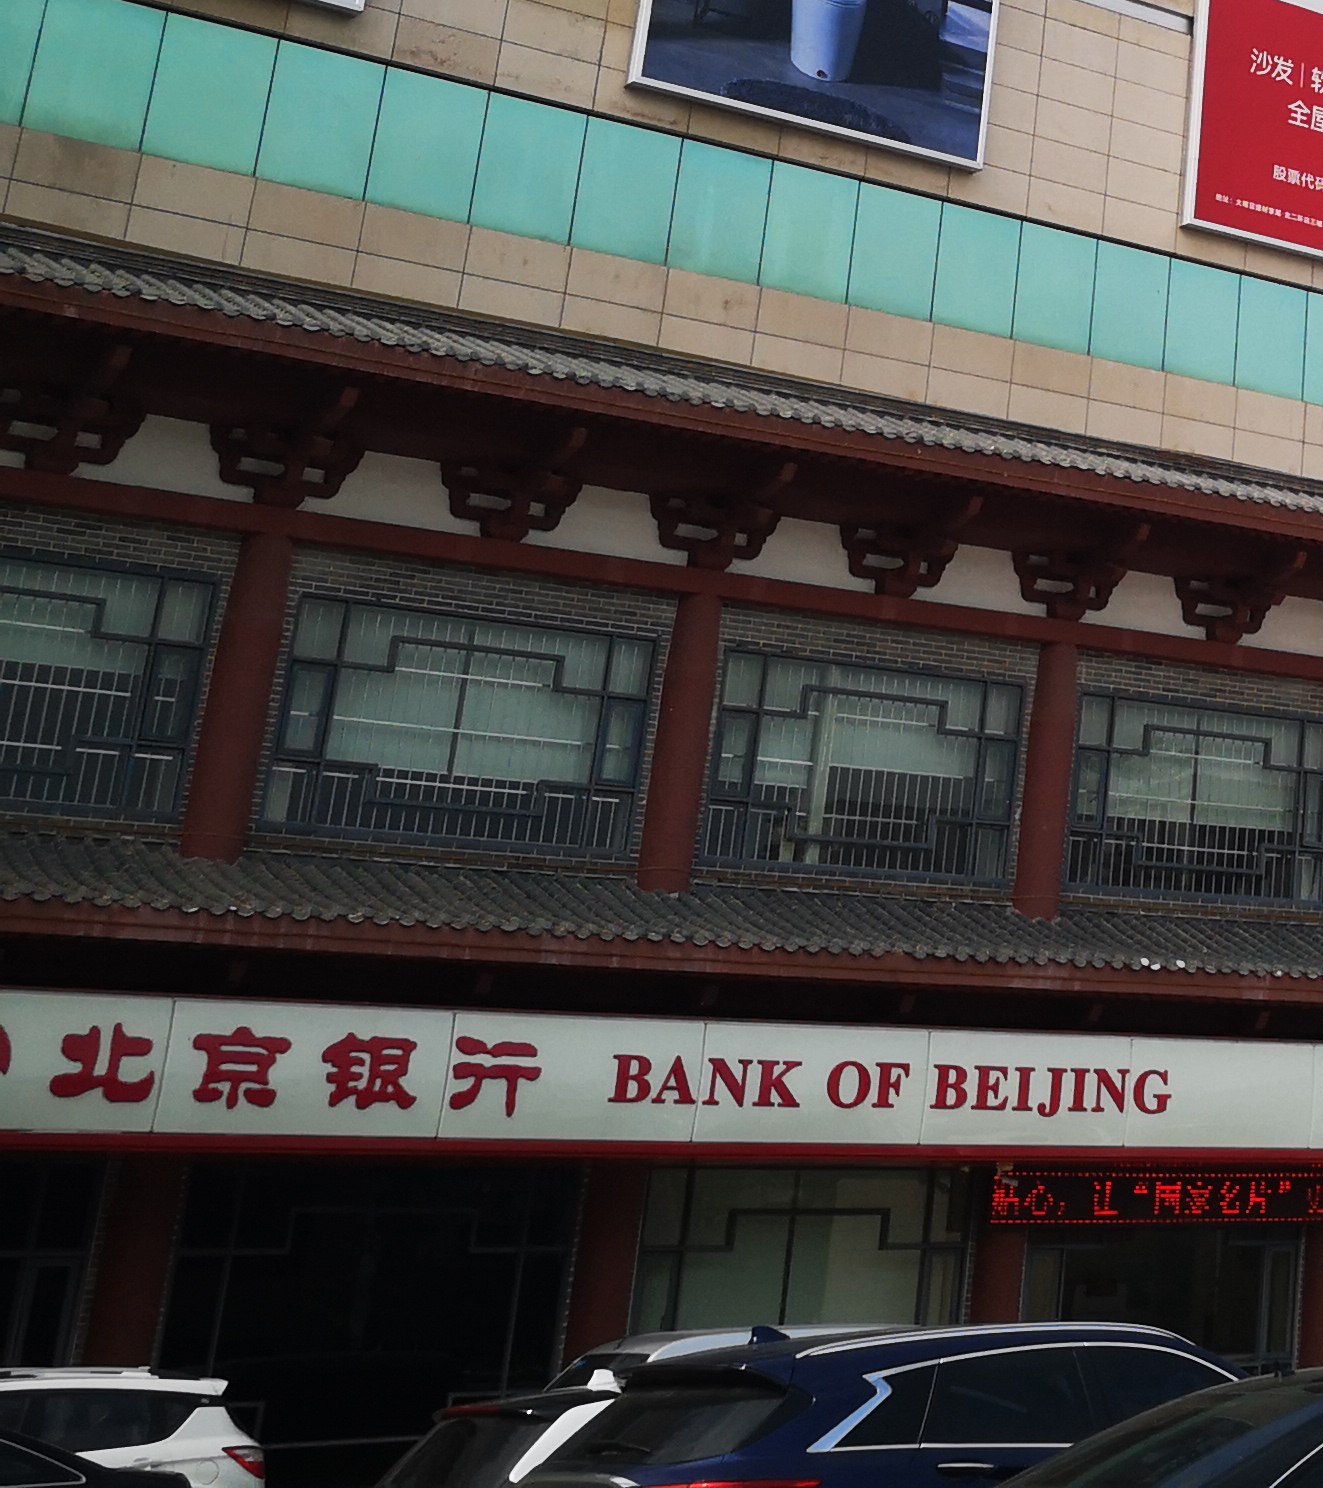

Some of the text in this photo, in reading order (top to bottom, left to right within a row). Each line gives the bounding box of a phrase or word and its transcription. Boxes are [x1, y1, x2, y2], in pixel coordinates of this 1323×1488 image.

[50, 1022, 543, 1118] 北京银行
[608, 1053, 1173, 1117] BANK OF BEIJING
